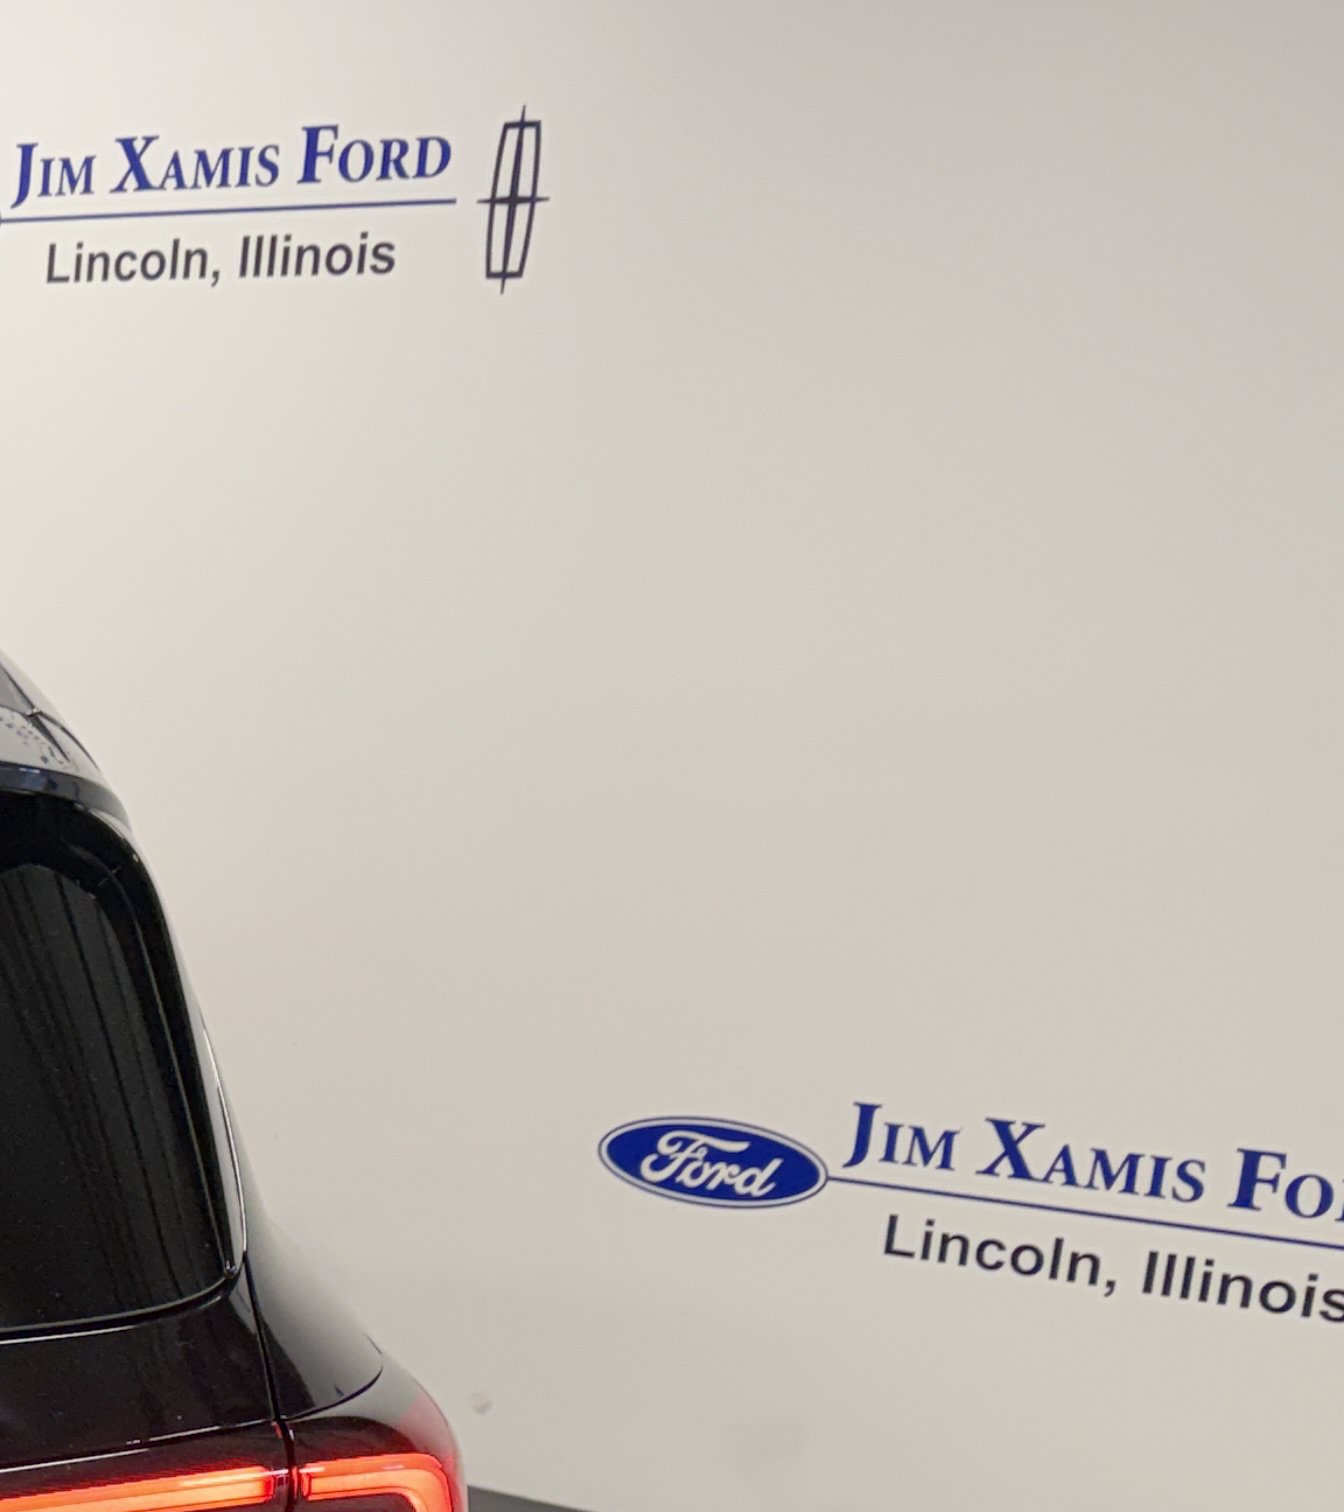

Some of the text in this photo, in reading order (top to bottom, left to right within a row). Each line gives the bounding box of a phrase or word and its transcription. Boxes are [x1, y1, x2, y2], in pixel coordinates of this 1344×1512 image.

[10, 124, 452, 208] JIM XAMIS FORD
[45, 232, 396, 287] Lincoln, Illinois
[639, 1130, 785, 1198] Ford
[841, 1102, 1344, 1222] JIM XAMIS FO
[883, 1213, 1344, 1324] Lincoln, Illinois
